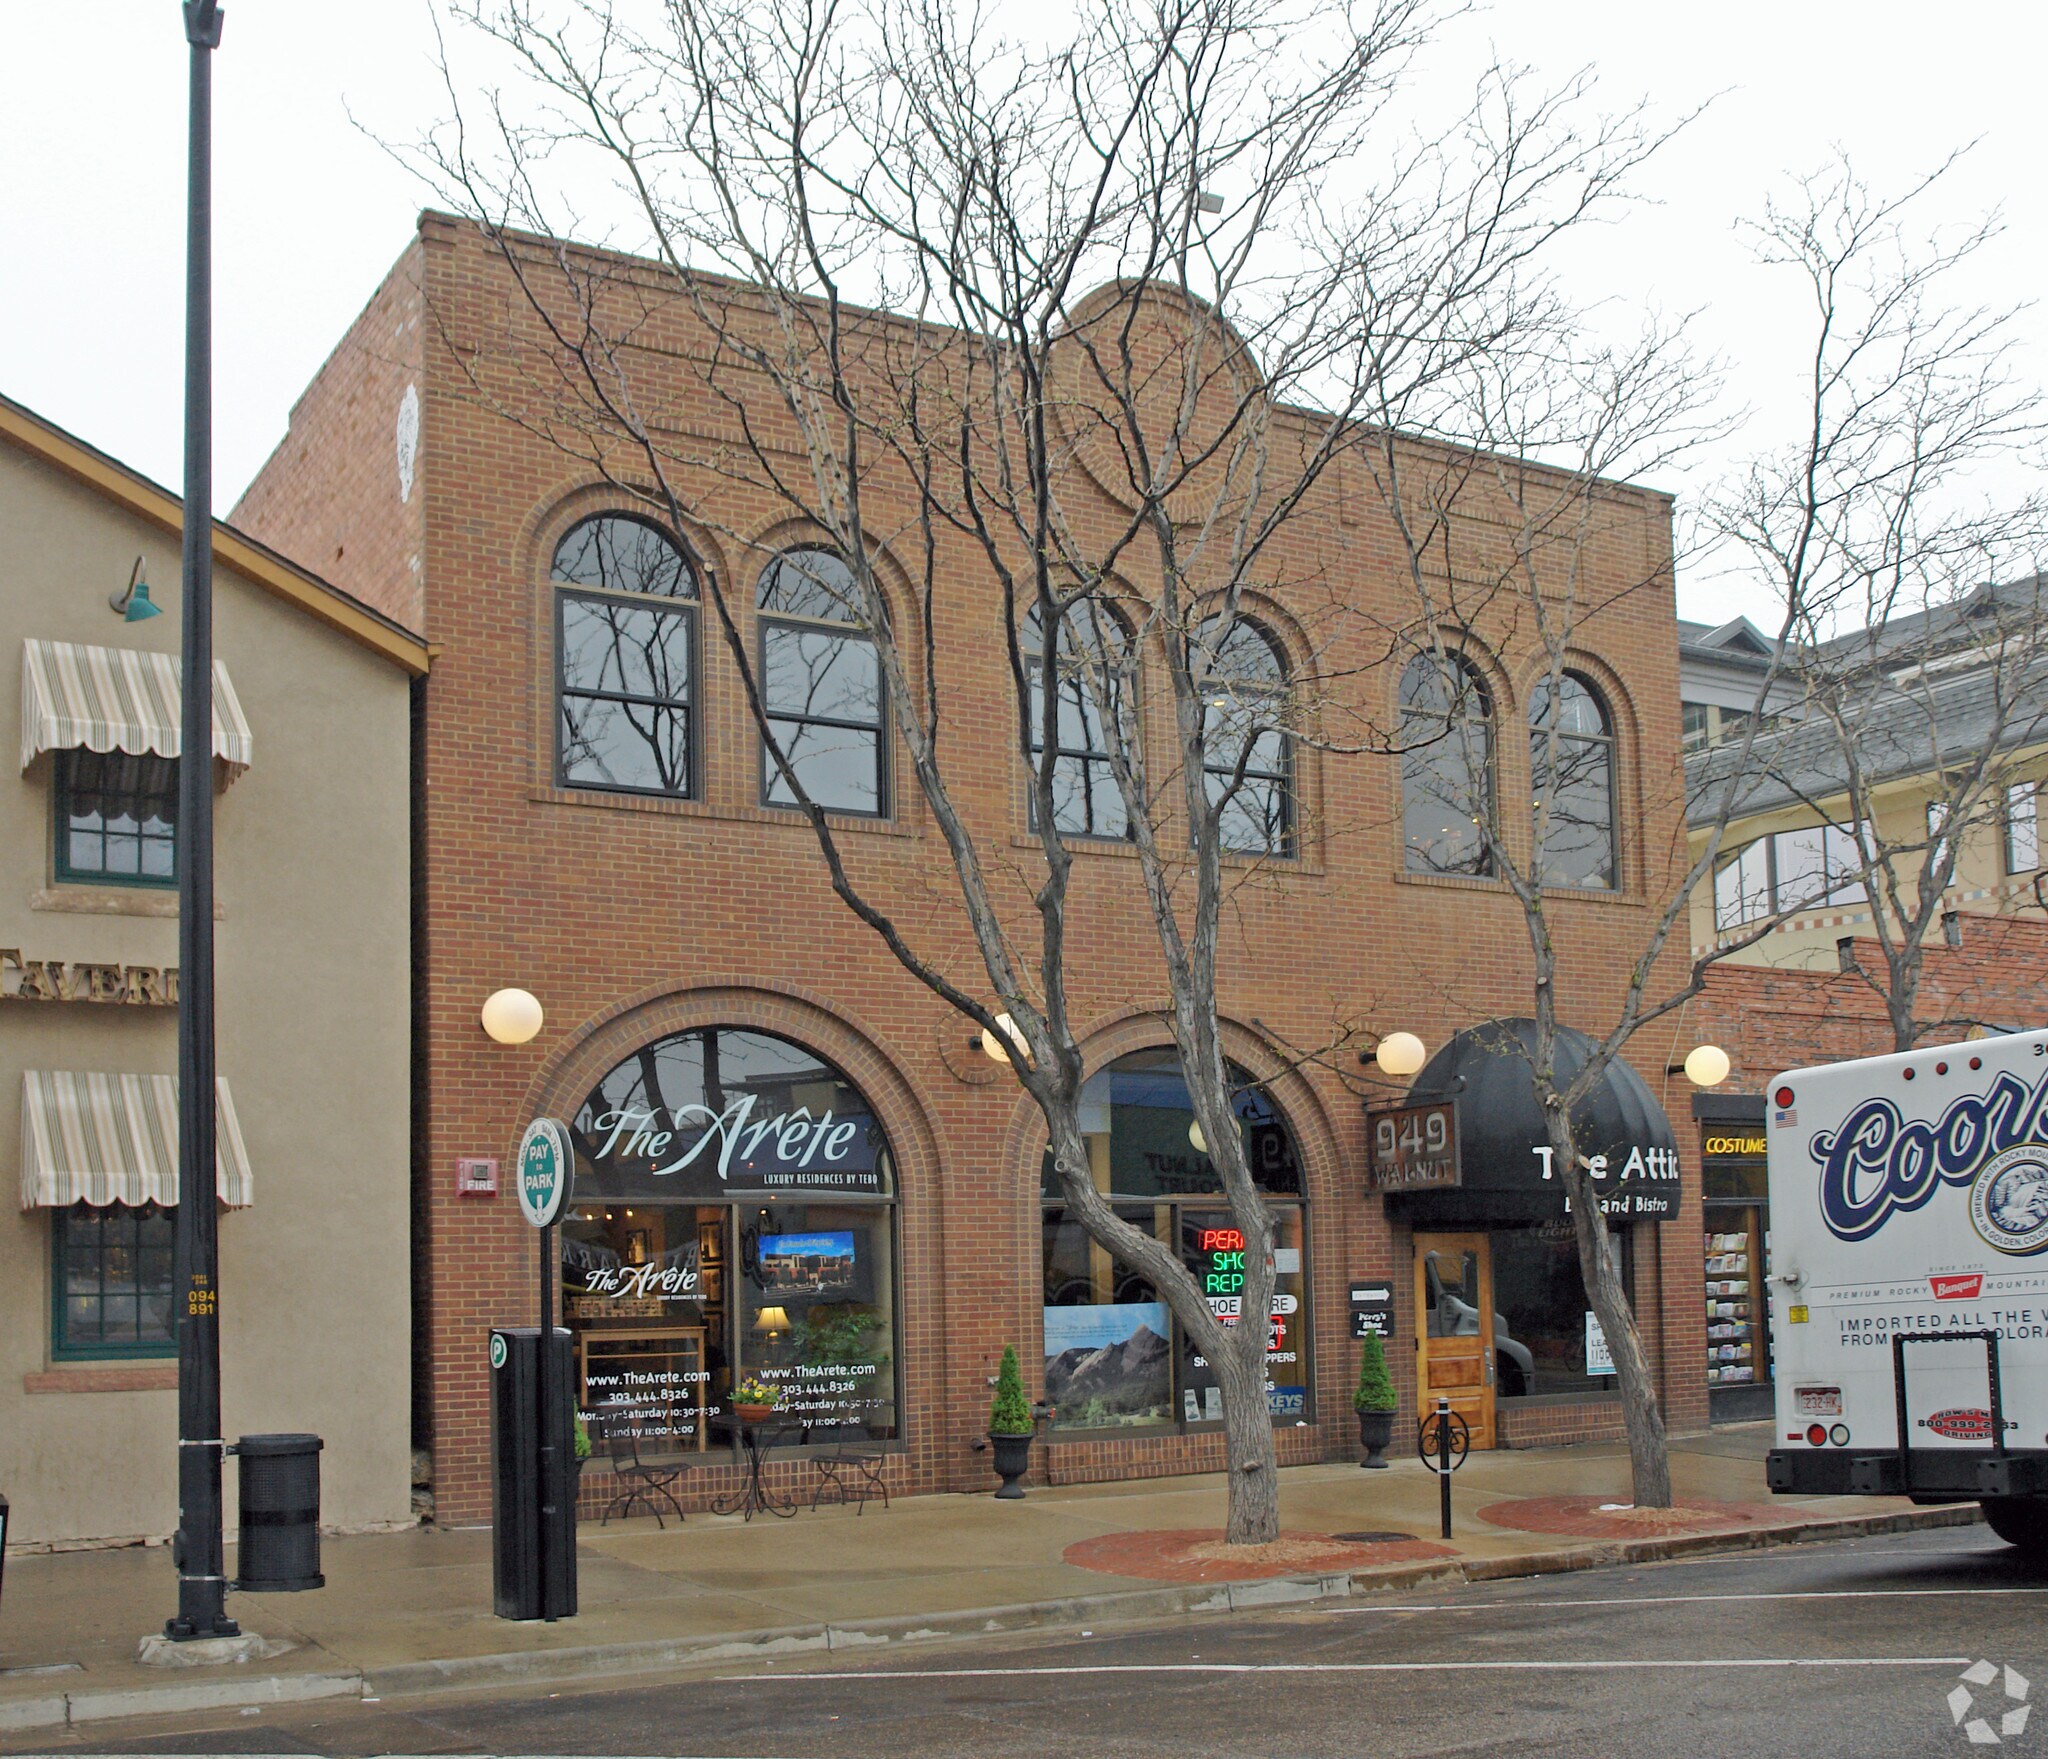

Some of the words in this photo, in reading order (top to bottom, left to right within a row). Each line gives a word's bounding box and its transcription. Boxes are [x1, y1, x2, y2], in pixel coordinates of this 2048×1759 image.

[594, 1104, 674, 1160] The
[653, 1094, 857, 1180] Arête
[1376, 1112, 1447, 1158] 949
[529, 1143, 549, 1161] PAY
[1532, 1146, 1608, 1180] Te
[1620, 1145, 1679, 1180] Attic
[764, 1173, 794, 1185] LUXURY
[797, 1173, 843, 1185] RESIDENCES
[846, 1174, 856, 1184] BY
[858, 1174, 878, 1185] TEBO
[1374, 1159, 1452, 1185] WALNUT
[466, 1180, 496, 1191] FIRE
[525, 1172, 554, 1191] PARK
[1974, 1182, 1986, 1219] BREWED
[1981, 1161, 2000, 1181] WITH
[2000, 1150, 2028, 1166] ROCKY
[1601, 1195, 1630, 1214] and
[1635, 1196, 1668, 1212] Bistro
[1980, 1222, 1990, 1233] IN
[585, 1268, 620, 1292] The
[610, 1262, 698, 1299] Arête
[1936, 1277, 1979, 1297] Banquet
[188, 1290, 216, 1303] 094
[1829, 1289, 1881, 1300] PREMIUM
[1889, 1286, 1929, 1296] ROCKY
[188, 1303, 214, 1316] 891
[1840, 1314, 1942, 1331] IMPORTED
[1949, 1312, 1986, 1326] ALL
[1992, 1309, 2033, 1324] THE
[1841, 1332, 1888, 1347] FROM
[585, 1371, 711, 1387] www.TheArete.com
[760, 1364, 876, 1379] www.TheArete.com
[608, 1388, 689, 1404] 303.444.8326
[782, 1380, 856, 1397] 303.444.8326
[670, 1406, 720, 1418] 10:30-7:30
[645, 1425, 694, 1436] 11:00-4:00
[1943, 1429, 1992, 1438] DRIVING
